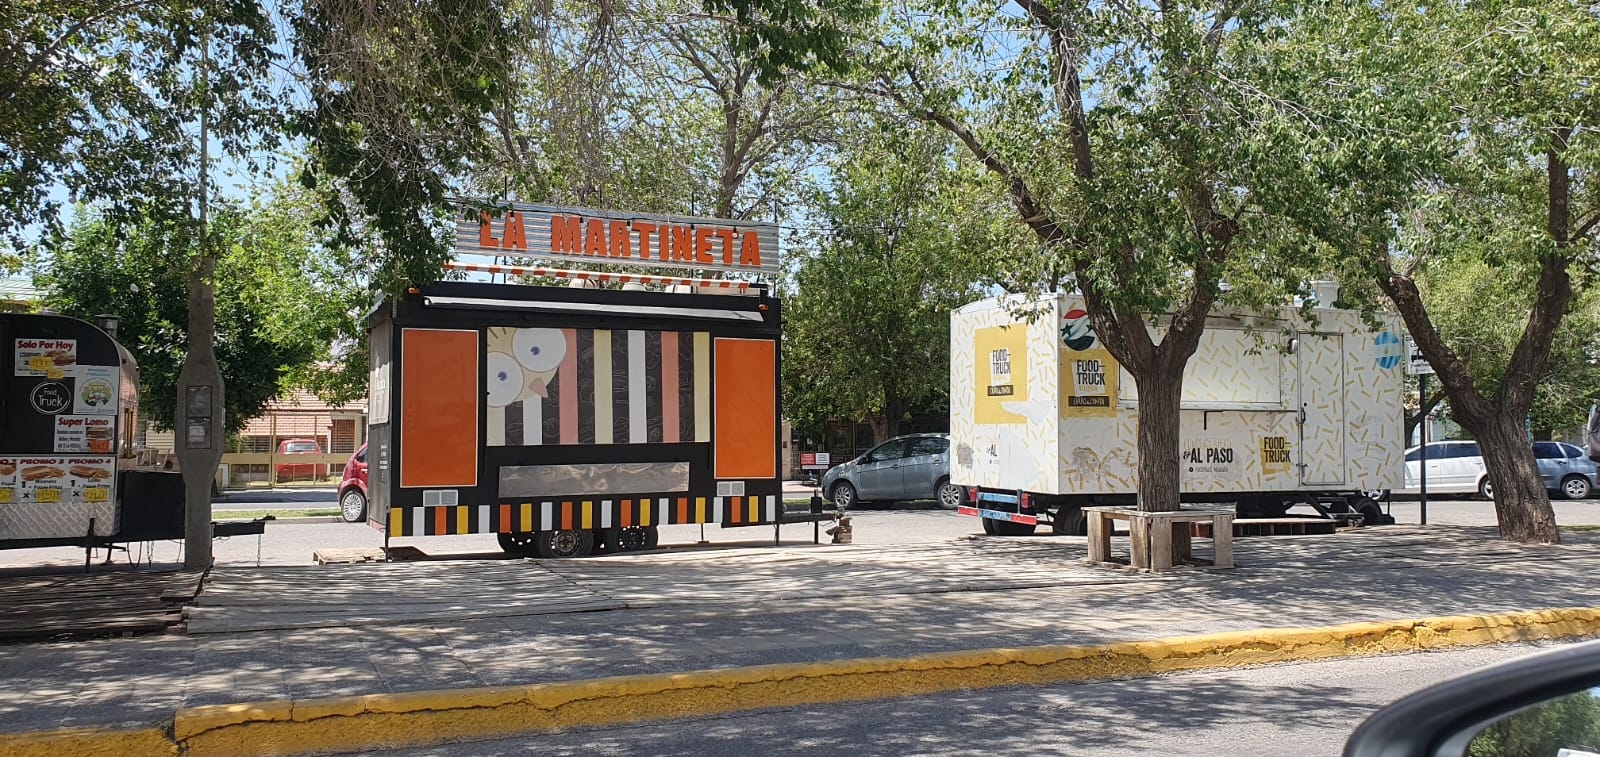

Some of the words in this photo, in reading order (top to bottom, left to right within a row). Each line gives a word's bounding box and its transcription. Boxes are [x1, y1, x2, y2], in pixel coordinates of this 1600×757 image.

[479, 210, 528, 249] LA
[551, 214, 761, 267] MARTINETA
[18, 340, 37, 349] Solo
[39, 341, 54, 349] Por
[56, 341, 73, 352] Hoy
[993, 362, 1011, 374] TRUCK
[1077, 372, 1105, 385] TRUCK
[38, 394, 63, 407] Truck
[58, 417, 83, 428] Super
[85, 418, 109, 426] Lomo
[1206, 448, 1234, 463] PASO
[1264, 450, 1291, 463] TRUCK
